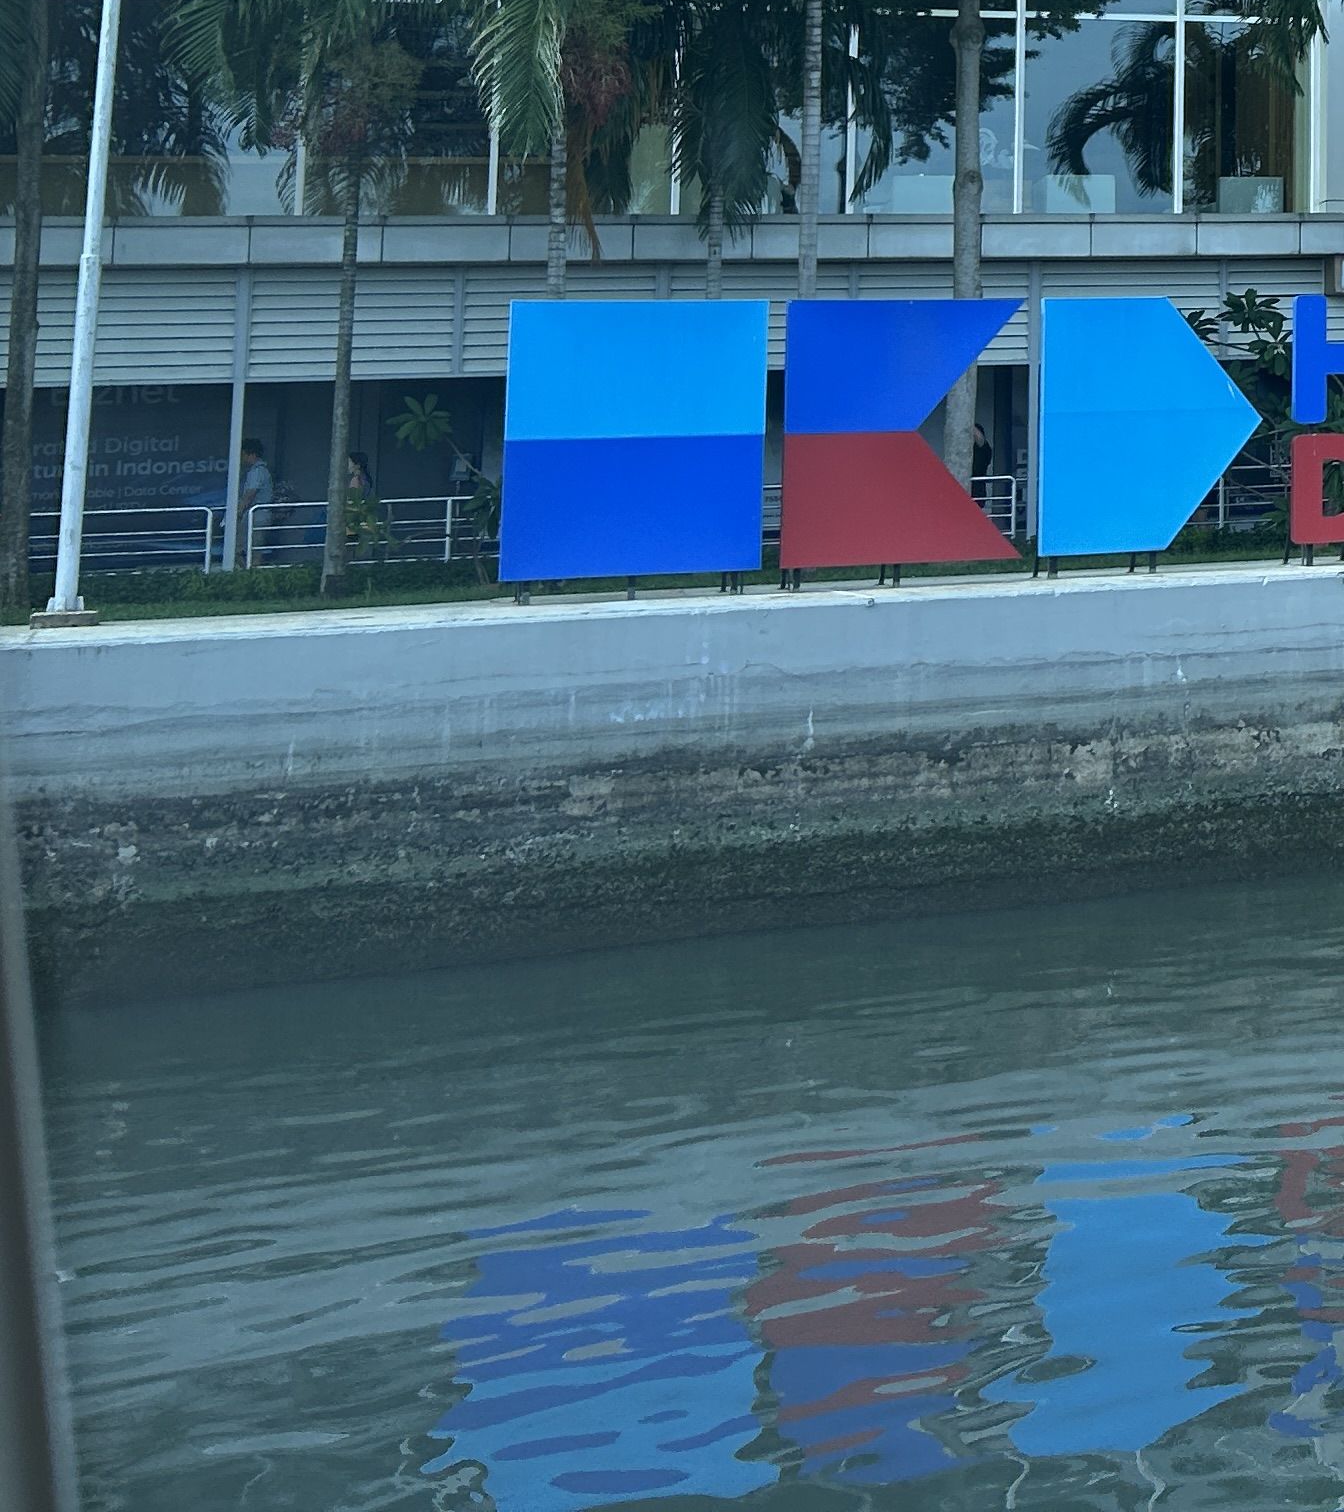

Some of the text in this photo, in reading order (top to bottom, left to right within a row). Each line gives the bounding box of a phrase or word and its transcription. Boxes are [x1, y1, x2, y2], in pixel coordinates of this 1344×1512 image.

[104, 435, 180, 456] Digital
[124, 485, 156, 497] Data
[159, 484, 203, 496] Center
